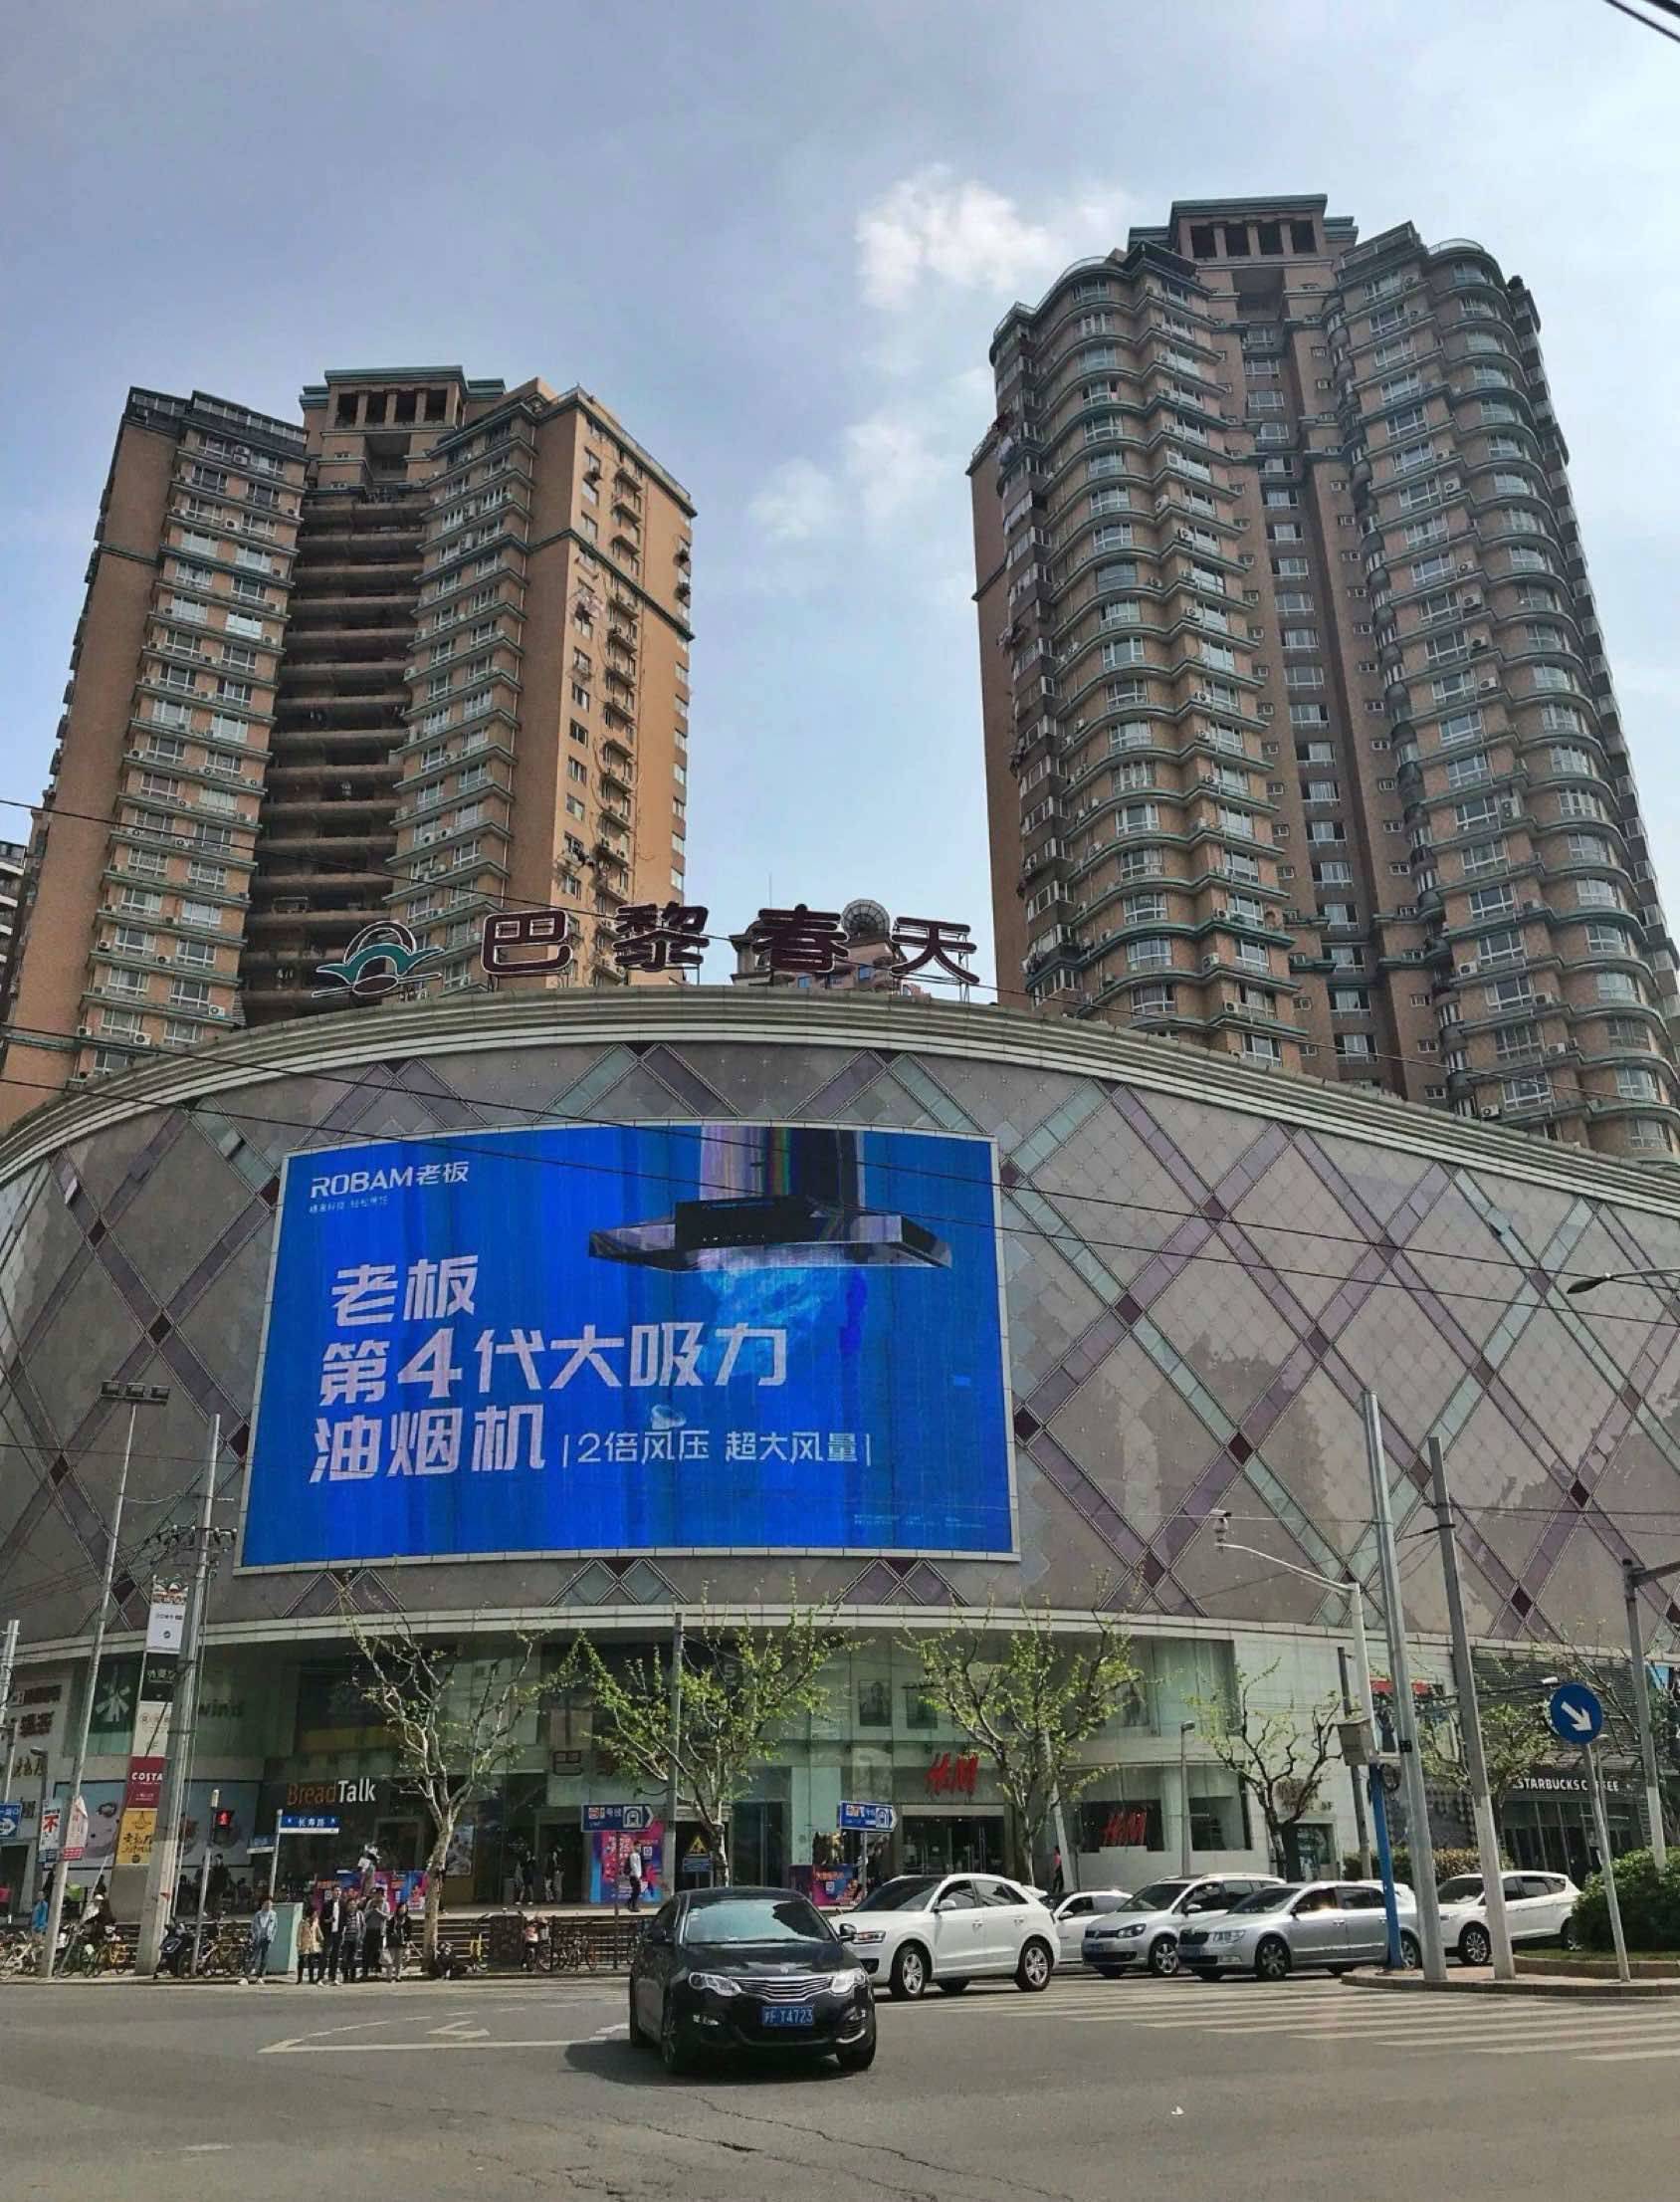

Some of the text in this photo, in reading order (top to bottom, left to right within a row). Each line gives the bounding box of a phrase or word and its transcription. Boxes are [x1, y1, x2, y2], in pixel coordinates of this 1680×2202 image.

[480, 902, 979, 985] 巴黎春天
[311, 1161, 471, 1199] ROBAM 老板
[330, 1254, 480, 1328] 老板
[318, 1321, 787, 1407] 第4代大吸力
[309, 1404, 545, 1483] 油烟机
[576, 1429, 860, 1464] 2倍风压 超大风量
[131, 1772, 163, 1781] COSTA
[287, 1777, 376, 1806] BreadTalk
[925, 1752, 979, 1793] H&M
[1517, 1777, 1580, 1791] STARBUCKS
[1103, 1806, 1148, 1848] H&M
